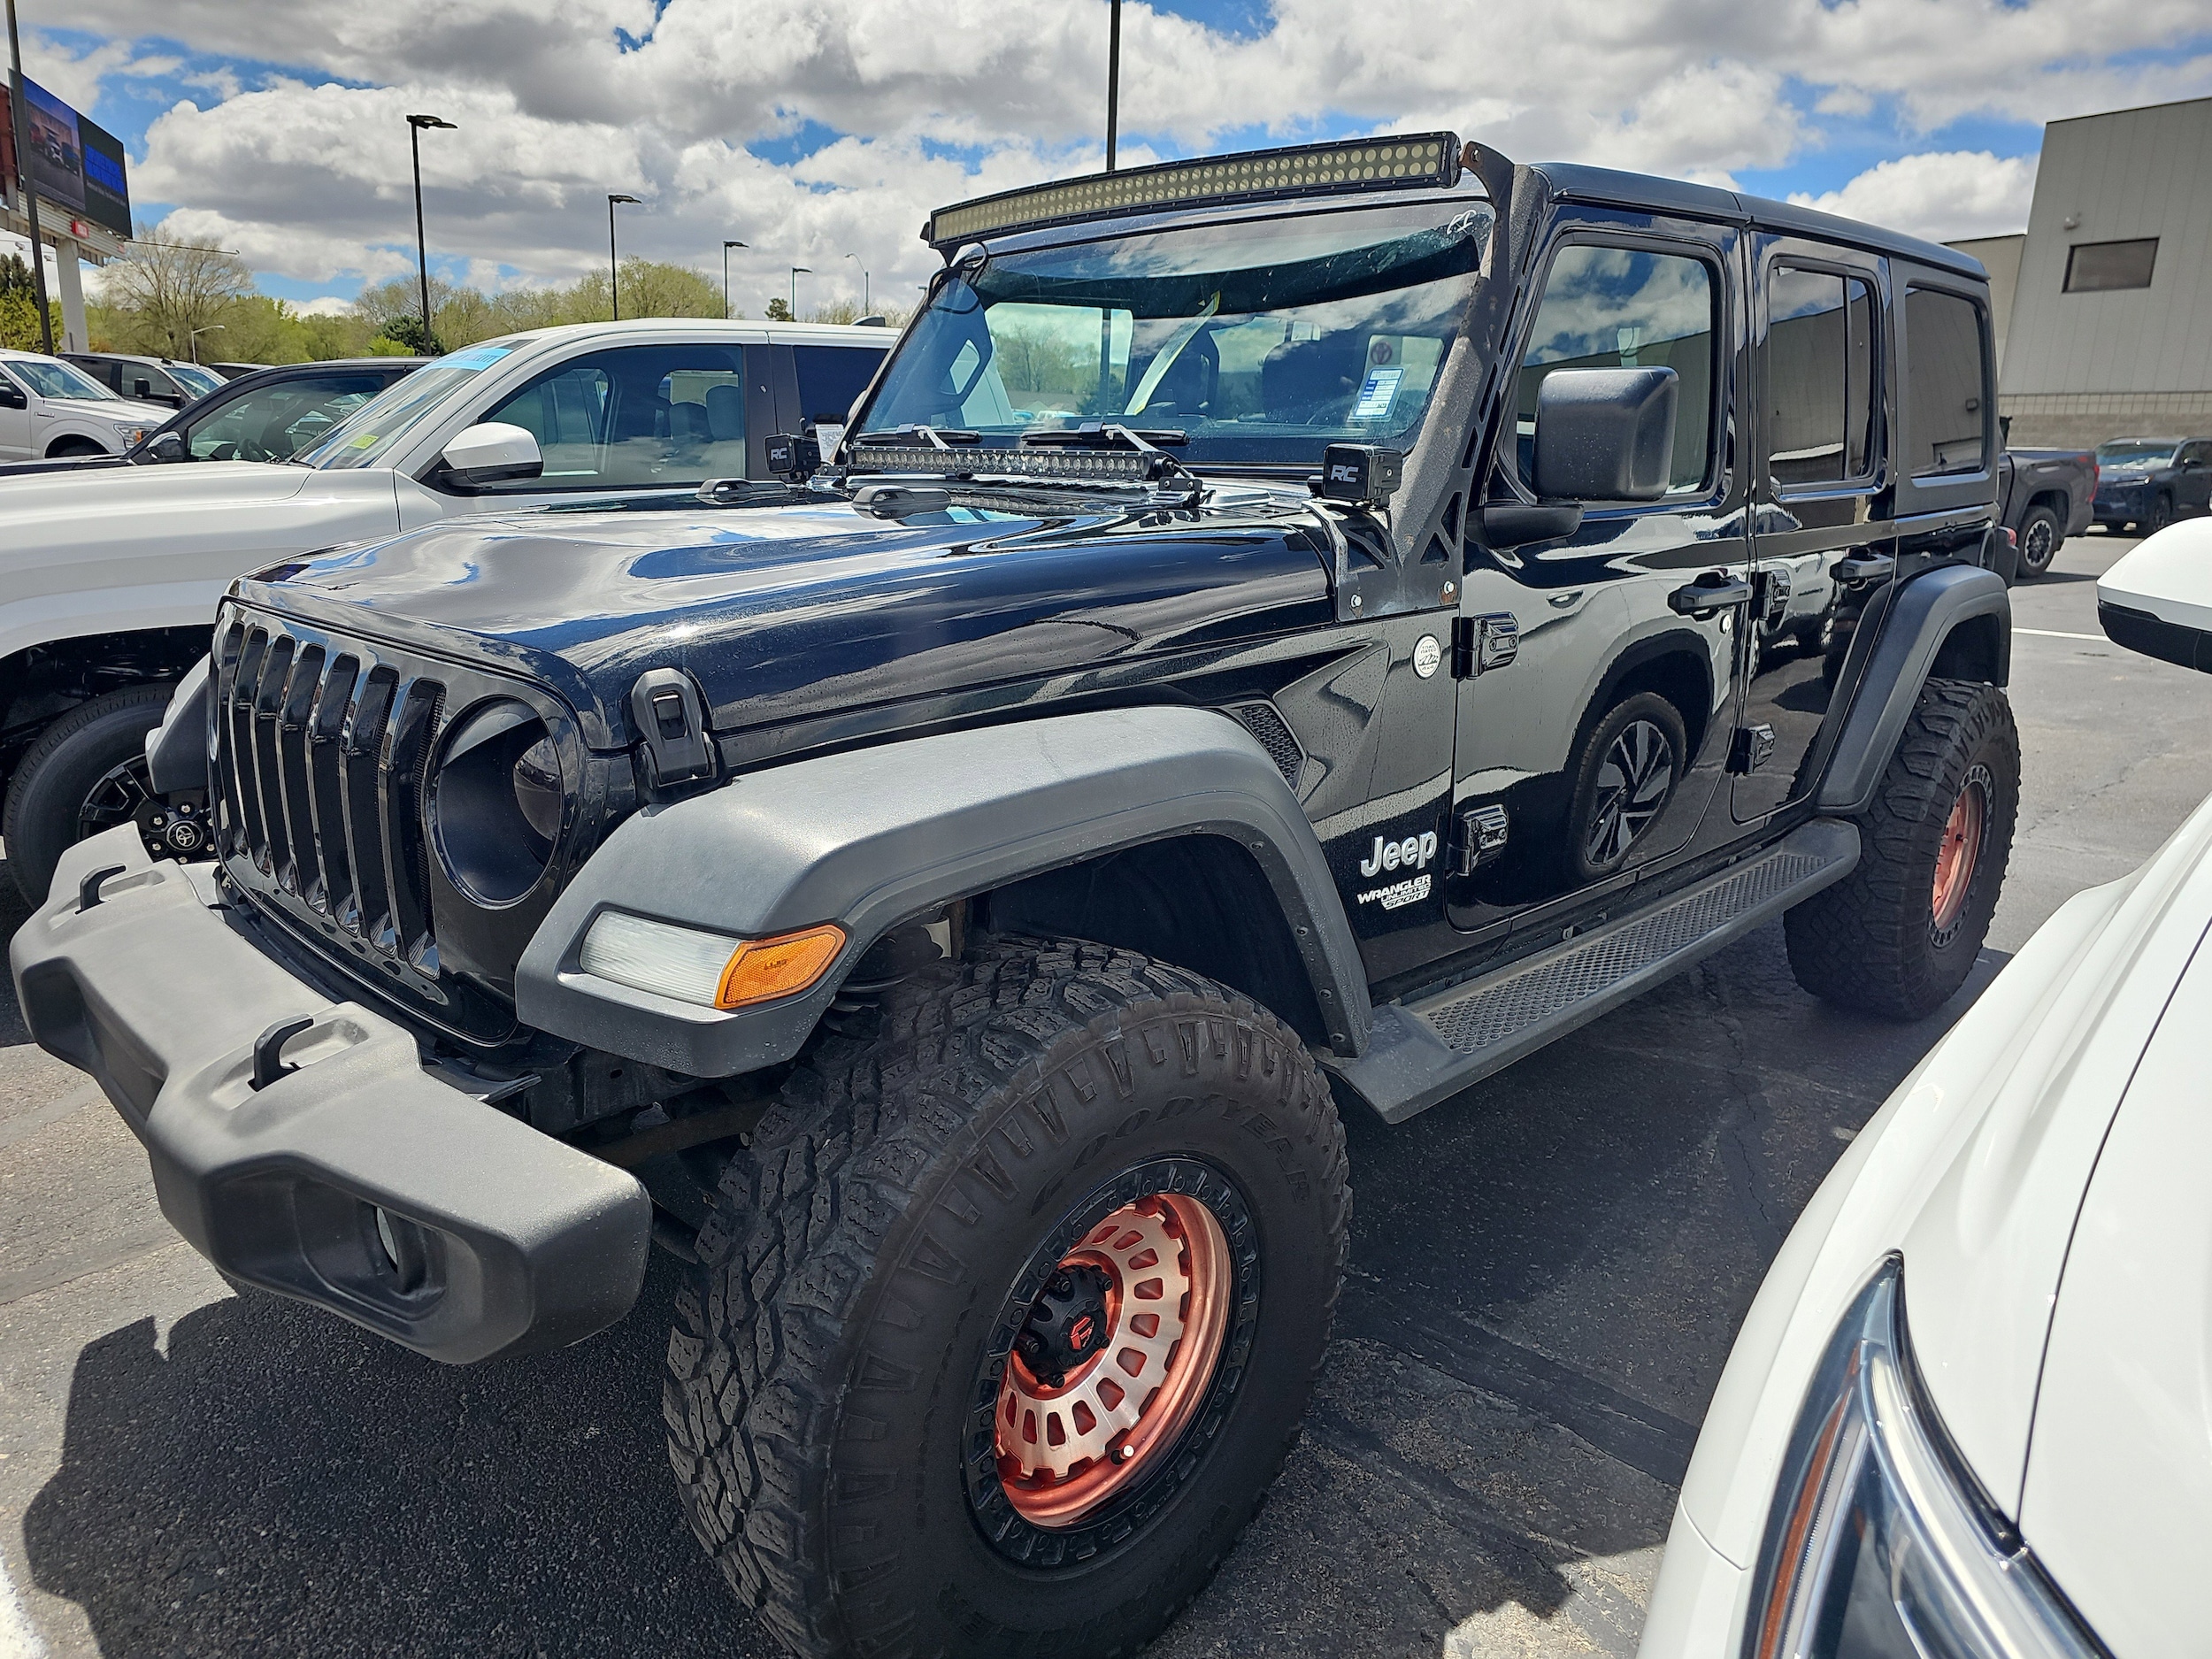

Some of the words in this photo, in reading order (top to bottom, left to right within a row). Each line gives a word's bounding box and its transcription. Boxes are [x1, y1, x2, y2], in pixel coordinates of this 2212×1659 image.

[770, 447, 787, 461] RC
[1330, 465, 1360, 483] RC
[1360, 831, 1438, 877] Jeep
[1356, 874, 1432, 904] WRANGLER
[1380, 882, 1432, 902] UNLIMITED
[1384, 889, 1430, 910] SPORT
